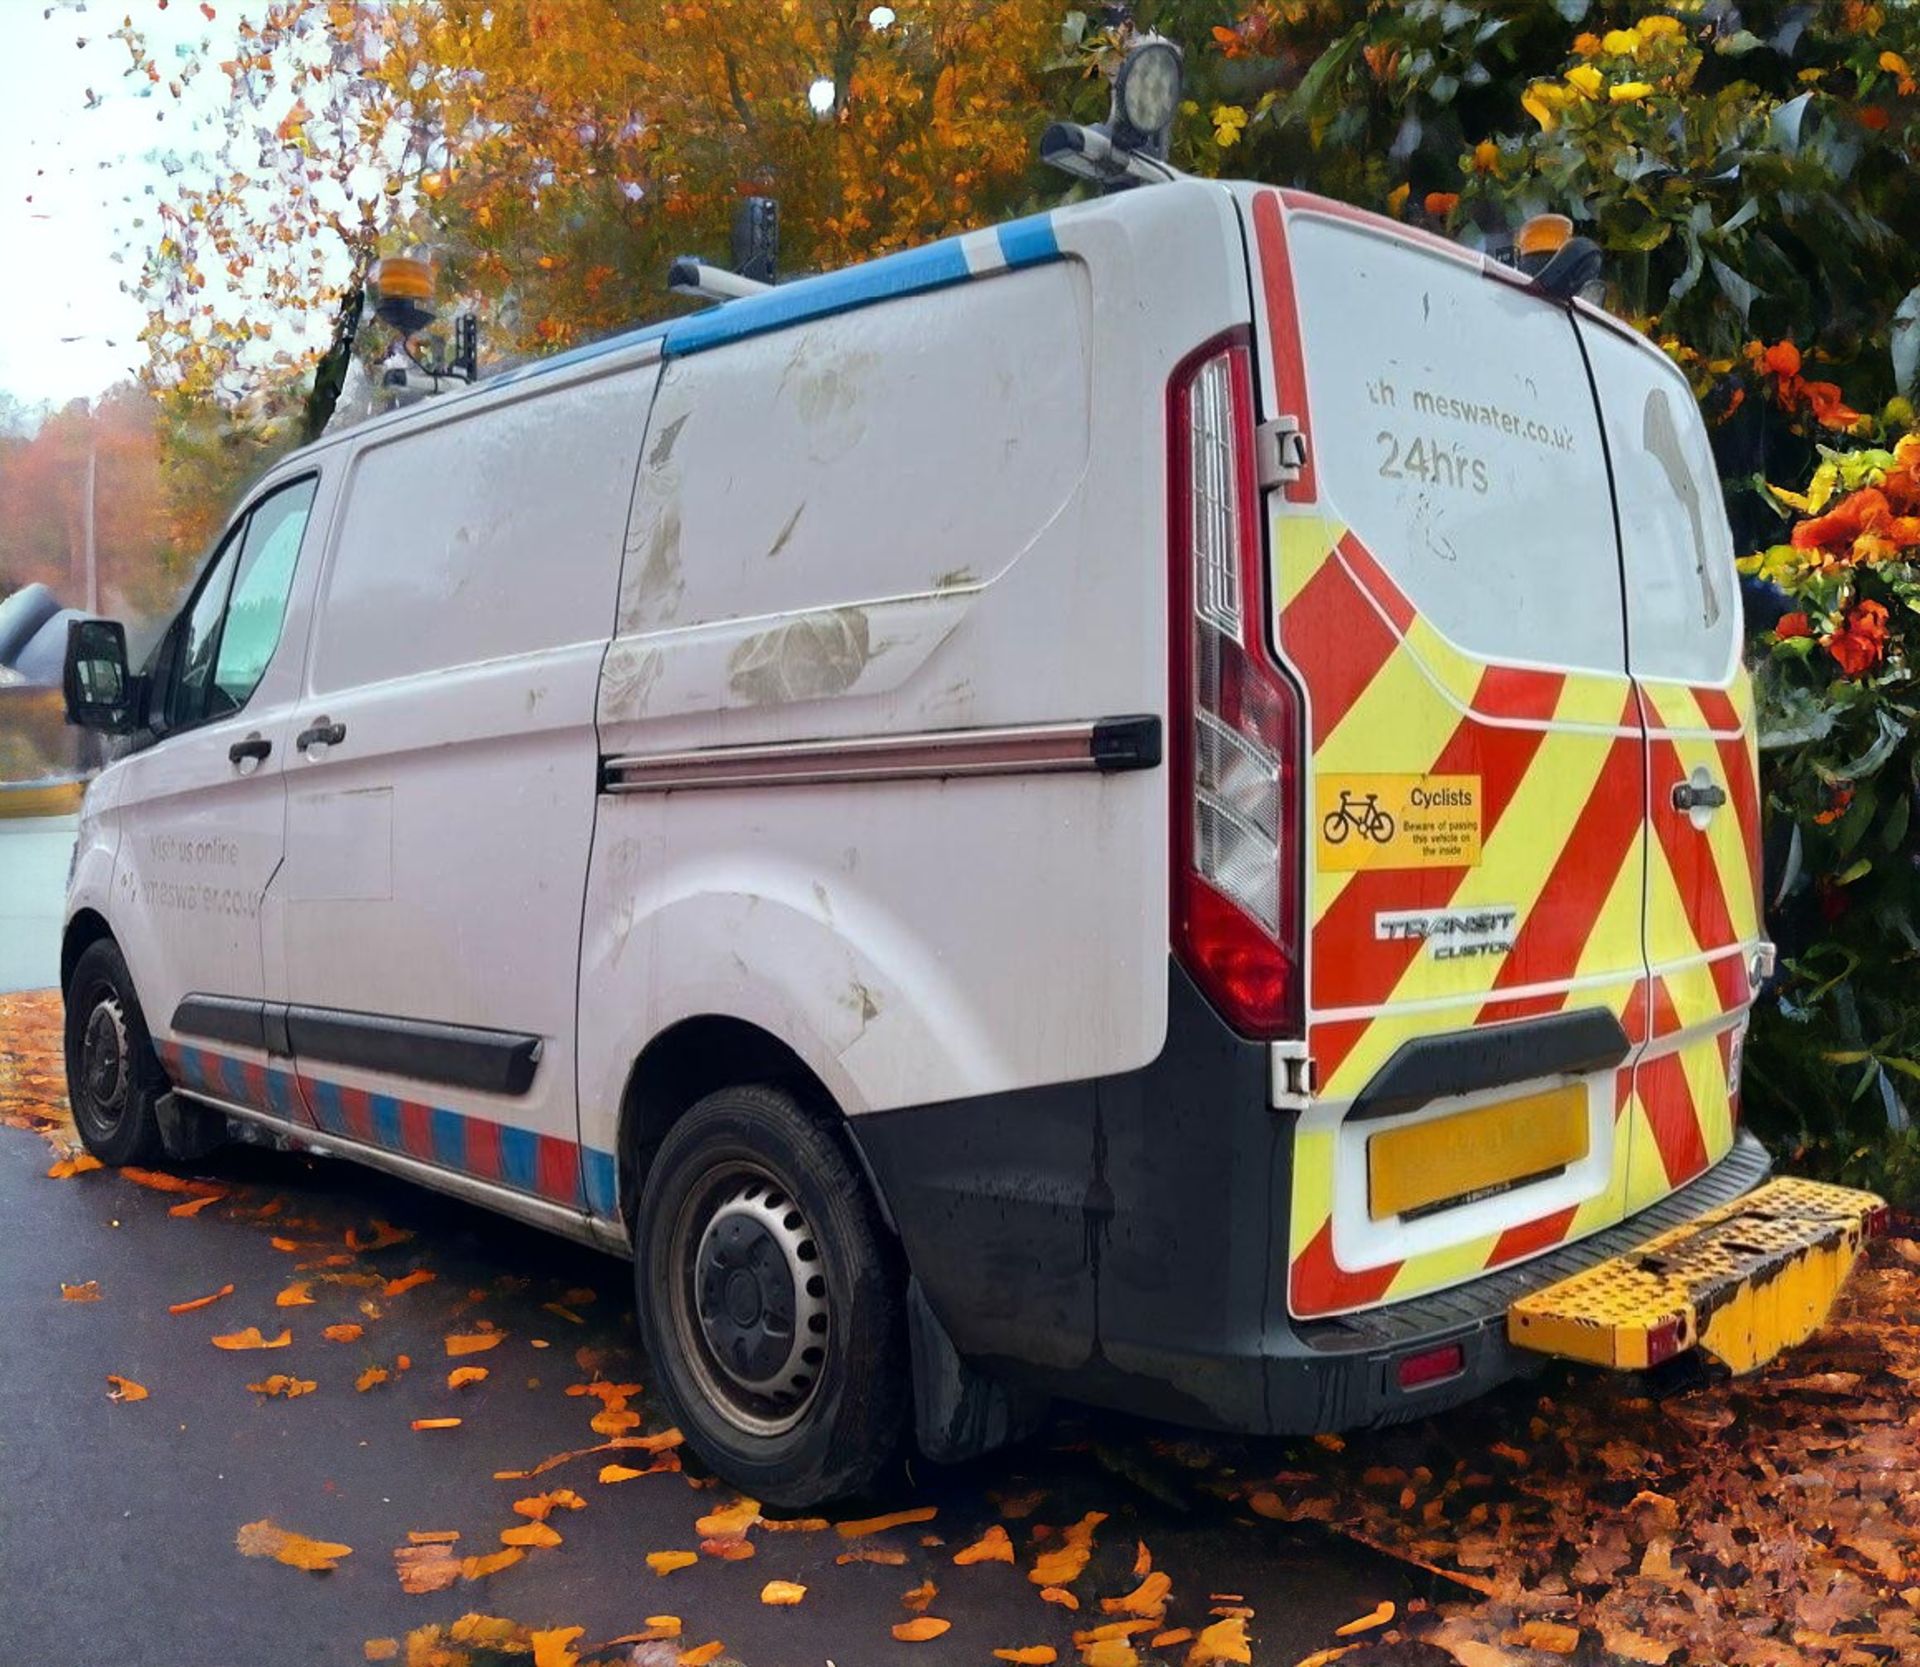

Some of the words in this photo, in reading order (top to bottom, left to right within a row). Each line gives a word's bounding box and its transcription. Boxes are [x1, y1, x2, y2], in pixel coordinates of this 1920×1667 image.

[1366, 378, 1574, 451] thmeswater.co.uk
[1377, 431, 1488, 493] 24hrs
[1411, 787, 1472, 810] Cyclists
[1403, 820, 1435, 832] Beware
[1437, 820, 1447, 831] of
[1449, 821, 1478, 833] passing
[1412, 834, 1428, 844] this
[1431, 833, 1458, 843] vehicle
[1460, 834, 1471, 843] on
[178, 841, 193, 863] us
[196, 836, 239, 865] online
[1422, 845, 1436, 856] the
[1439, 845, 1462, 856] inside
[1381, 911, 1516, 940] TRANSIT
